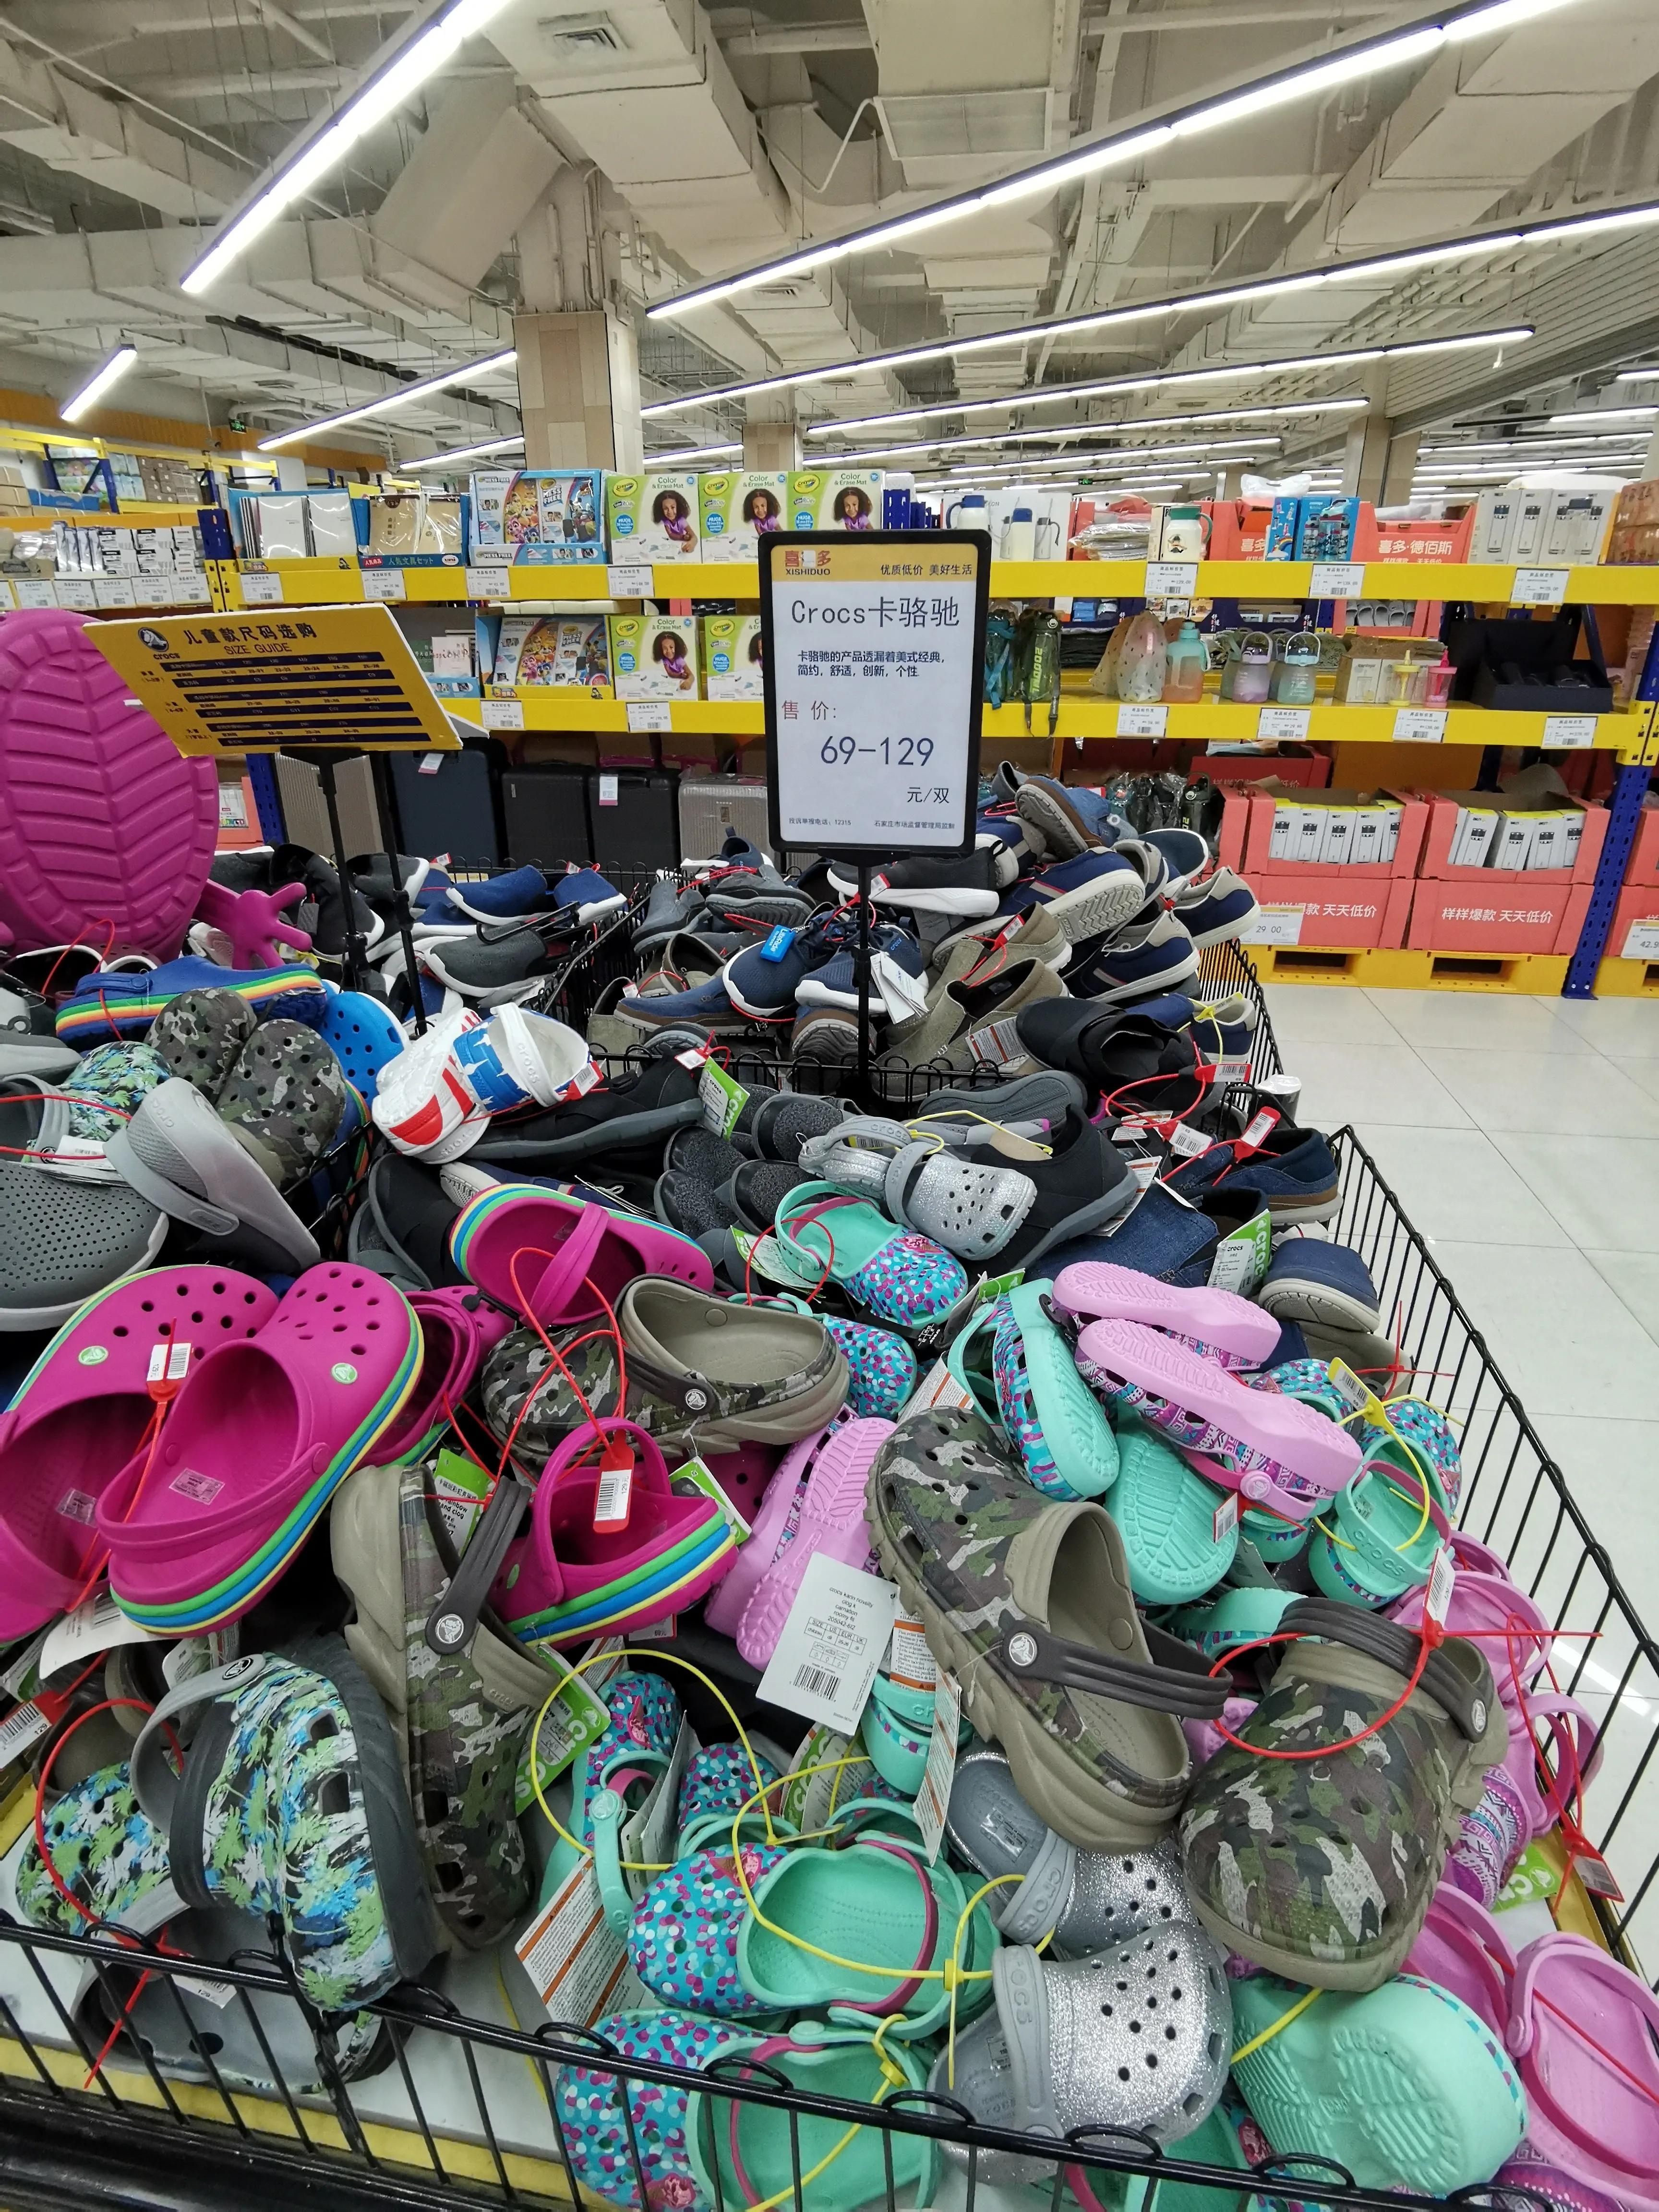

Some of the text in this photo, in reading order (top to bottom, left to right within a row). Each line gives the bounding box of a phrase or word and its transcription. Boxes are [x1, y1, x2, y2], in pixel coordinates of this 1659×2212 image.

[1379, 539, 1453, 555] 喜多·德佰斯
[785, 550, 831, 568] 喜多
[880, 564, 973, 576] 优质低价 美好生活
[792, 596, 960, 628] Crocs卡骆驰
[224, 641, 292, 655] SIZE GUIDE
[906, 787, 950, 805] 元/双
[1322, 903, 1377, 918] 天天低价
[1442, 907, 1554, 924] 样样爆款 天天低价
[890, 938, 902, 951] crocs
[517, 1041, 540, 1086] crocs
[709, 1079, 721, 1094] crocs
[452, 1508, 465, 1520] clog
[1354, 1528, 1407, 1576] crocs
[829, 1587, 842, 1596] crocs
[856, 1597, 874, 1608] novelty
[842, 1599, 852, 1608] clog
[833, 1611, 849, 1620] roomy
[835, 1604, 858, 1617] carnation
[812, 1619, 824, 1628] SIZE
[830, 1623, 837, 1632] US
[841, 1630, 853, 1639] EUR
[1017, 1868, 1063, 1930] crocs
